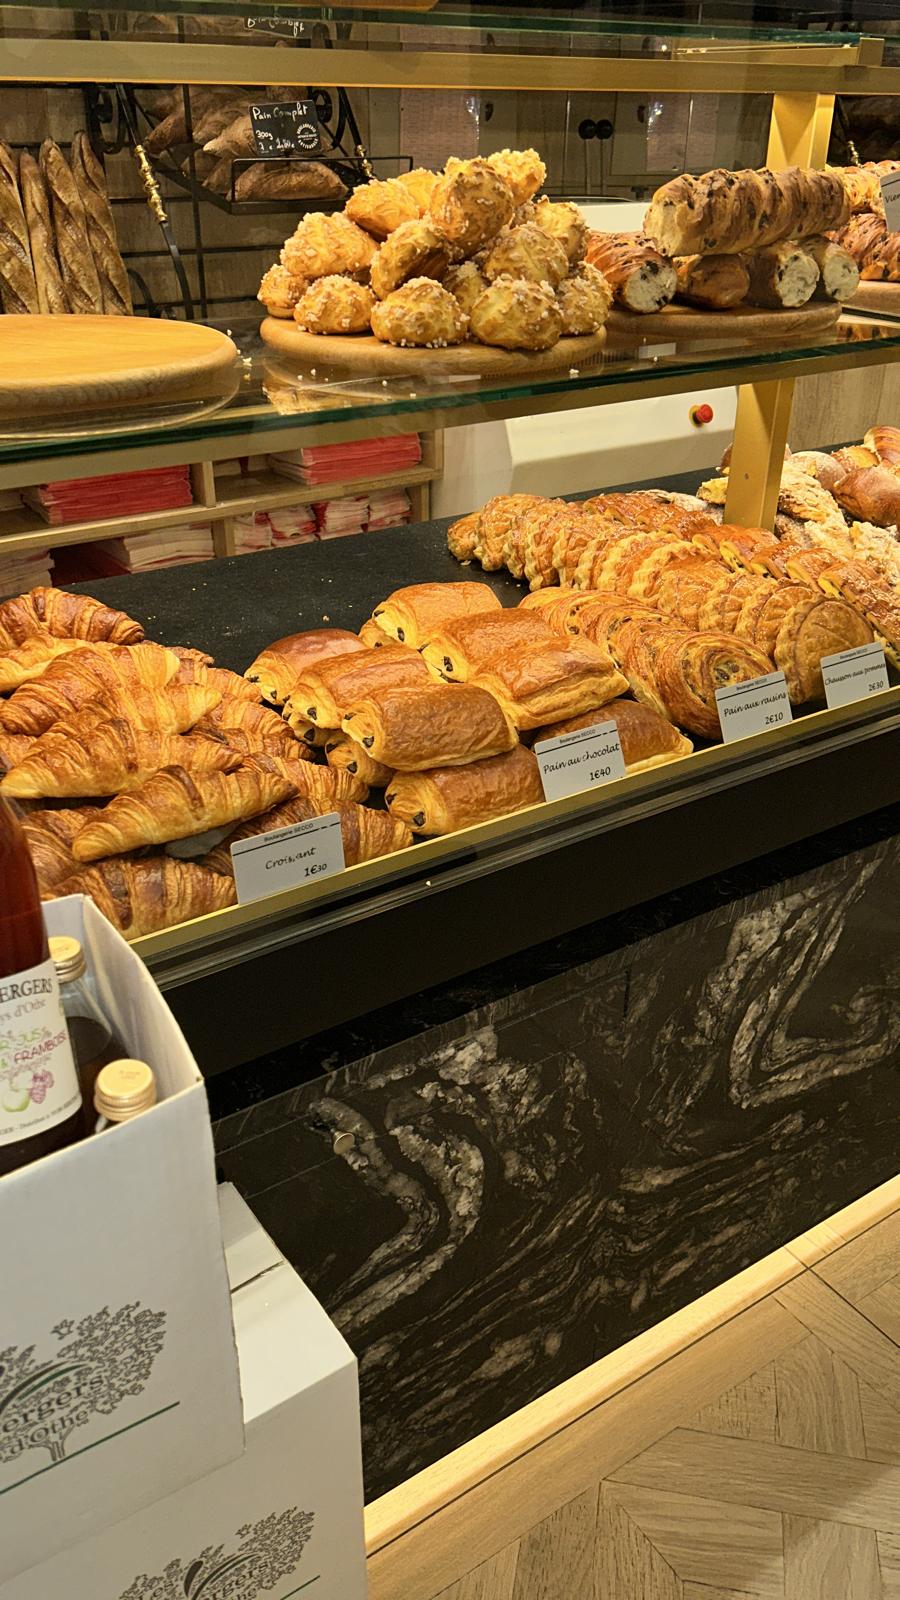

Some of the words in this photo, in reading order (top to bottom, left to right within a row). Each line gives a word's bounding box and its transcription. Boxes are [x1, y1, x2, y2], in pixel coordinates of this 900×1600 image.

[252, 106, 271, 120] Pain
[273, 101, 308, 122] Complet
[723, 704, 743, 717] Pain
[744, 701, 760, 711] aux
[761, 692, 787, 706] raisins
[765, 711, 784, 725] 2€10
[543, 761, 567, 774] Pain
[567, 757, 581, 766] au
[582, 743, 620, 762] chocolat
[589, 766, 611, 781] 1€40
[303, 863, 328, 877] 1€30
